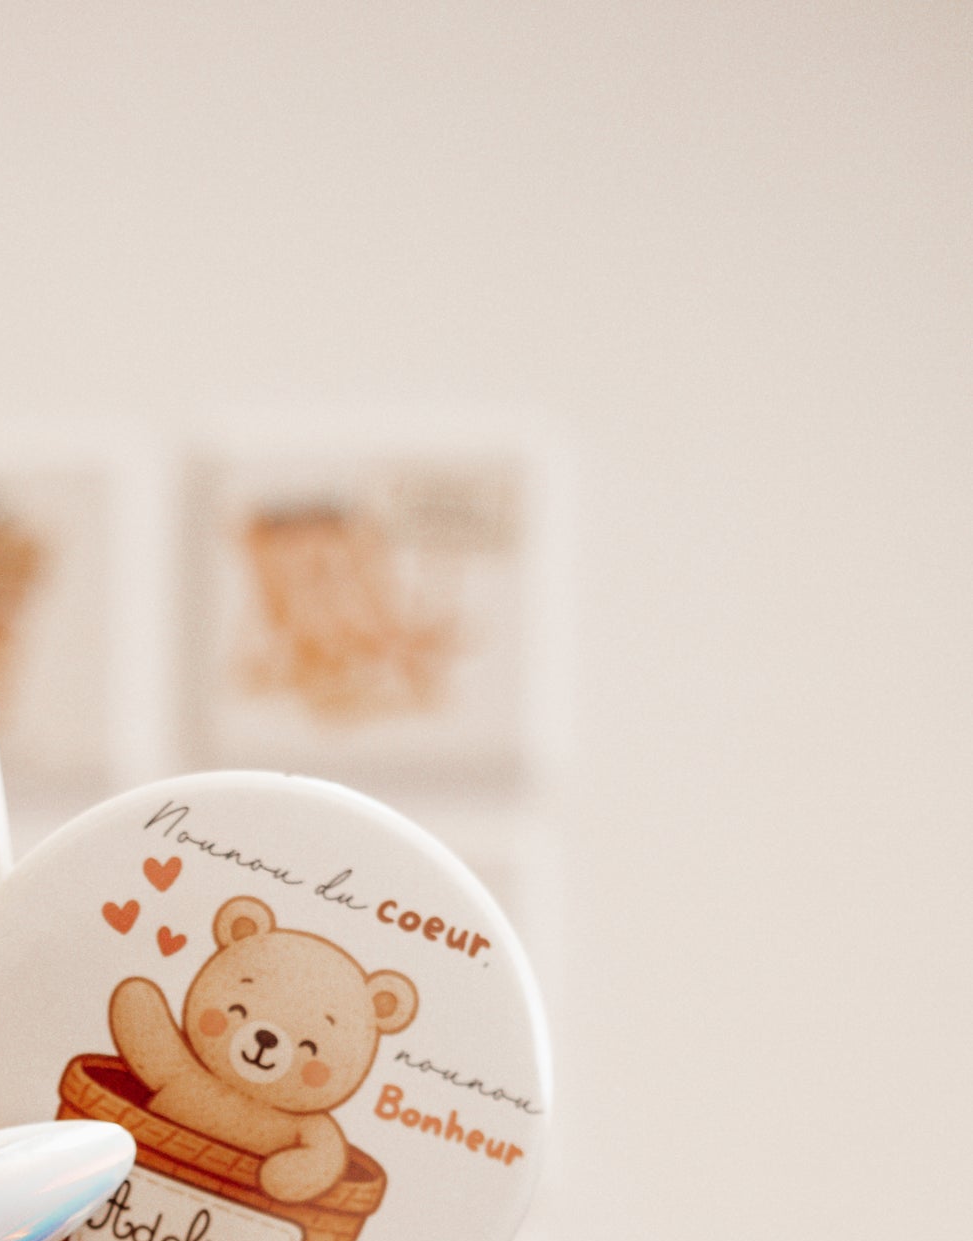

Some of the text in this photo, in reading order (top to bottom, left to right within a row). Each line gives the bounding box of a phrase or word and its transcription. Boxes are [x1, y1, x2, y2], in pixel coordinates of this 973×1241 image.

[143, 799, 305, 887] Nounou
[314, 868, 369, 912] du
[394, 1046, 544, 1117] nounou
[372, 1083, 525, 1168] Bonheur
